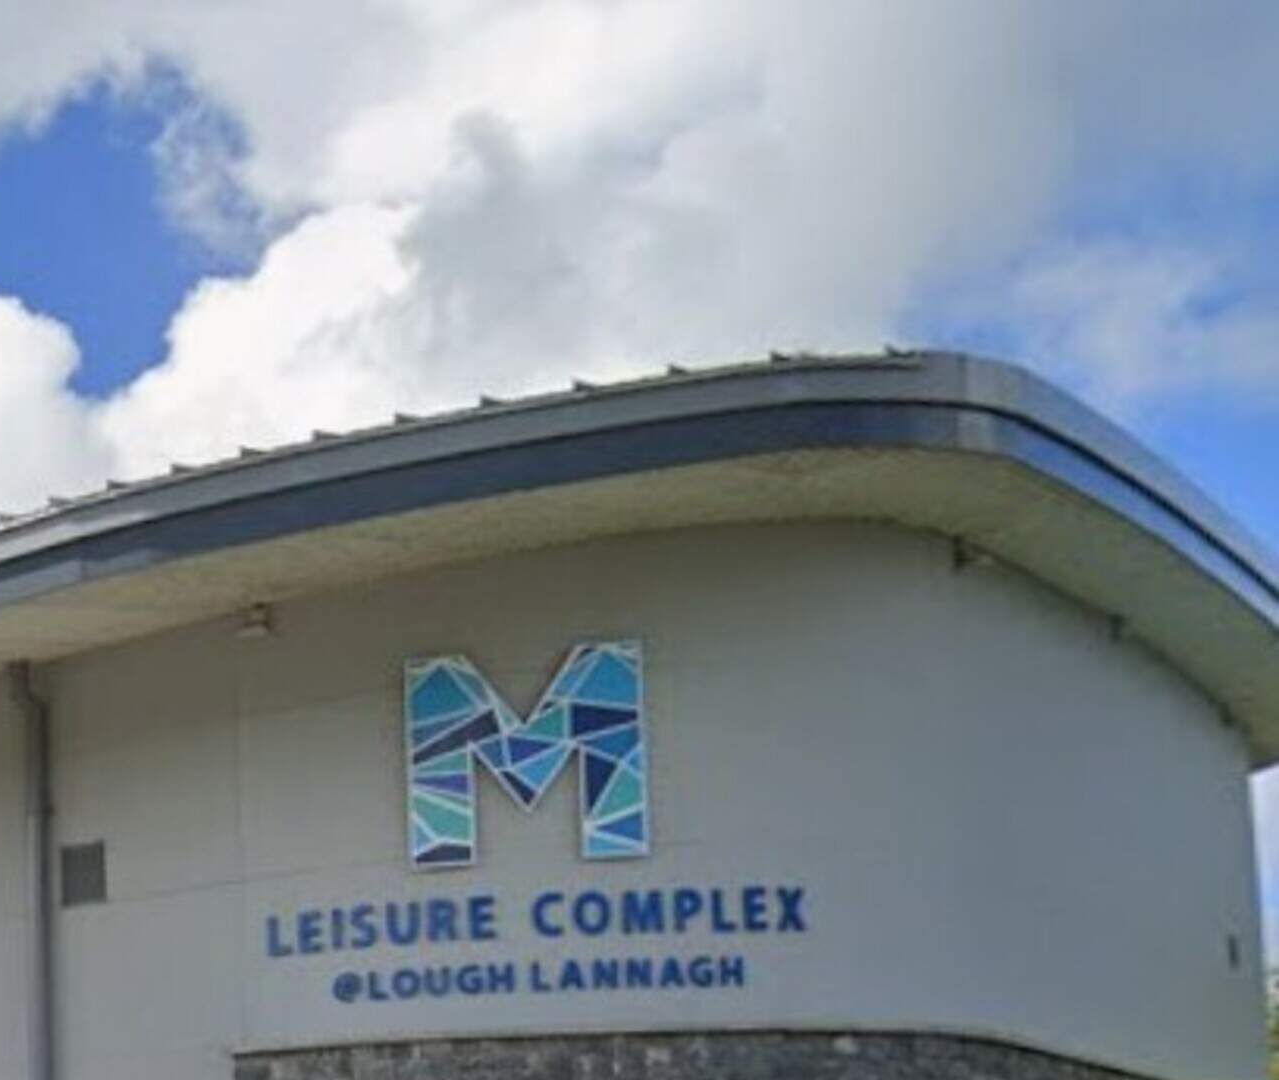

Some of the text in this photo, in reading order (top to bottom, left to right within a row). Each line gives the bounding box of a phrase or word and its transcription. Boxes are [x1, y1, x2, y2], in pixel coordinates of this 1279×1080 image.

[403, 638, 650, 870] M
[265, 885, 809, 958] LEISURE COMPLEX
[332, 956, 746, 1004] @LOUGH LANNAGH
